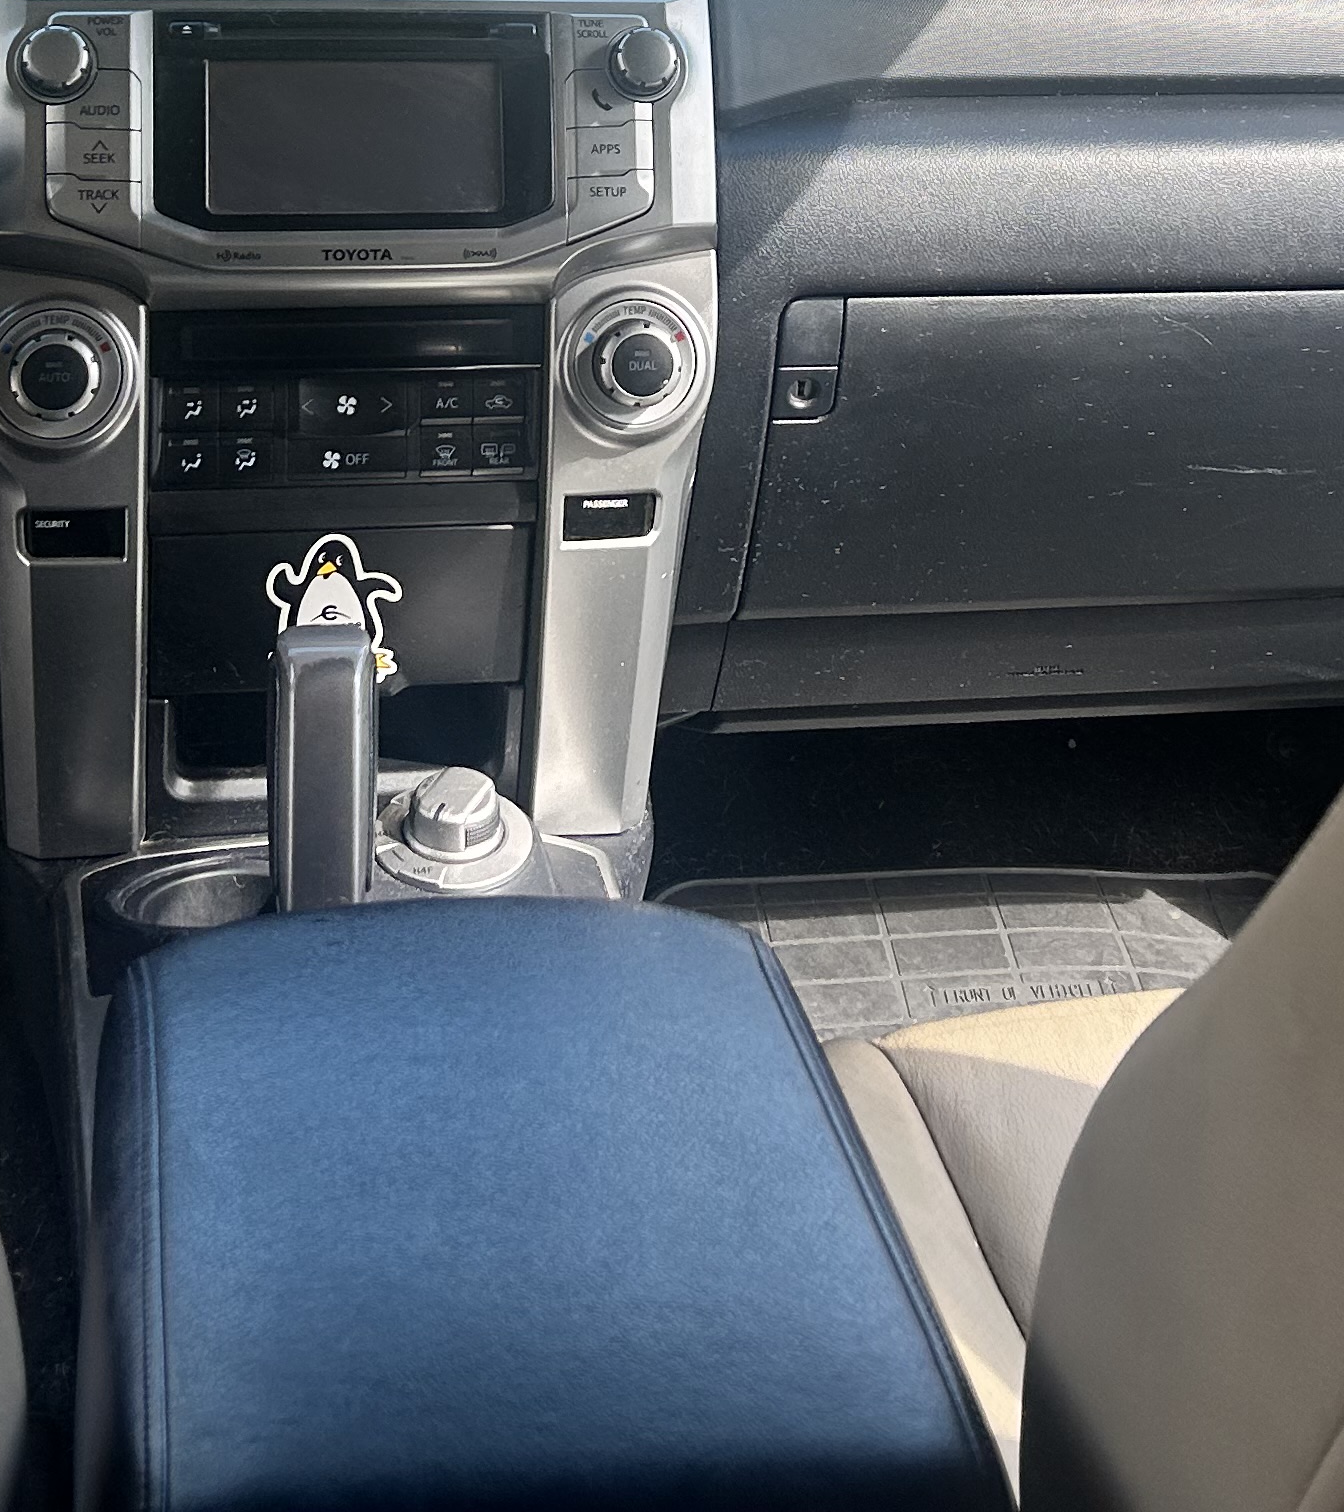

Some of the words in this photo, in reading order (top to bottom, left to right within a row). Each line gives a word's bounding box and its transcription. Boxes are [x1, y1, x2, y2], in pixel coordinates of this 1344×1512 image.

[578, 19, 605, 28] TUNE
[96, 27, 117, 37] VOL
[577, 29, 608, 38] SCROLL
[79, 104, 121, 116] AUDIO
[590, 143, 621, 155] APPS
[82, 152, 116, 164] SEEK
[77, 189, 120, 201] TRACK
[589, 186, 627, 198] SETUP
[321, 248, 393, 261] TOYOTA
[623, 305, 647, 316] TEMP
[44, 314, 71, 325] TEMP
[628, 360, 657, 371] DUAL
[38, 371, 71, 383] AUTO
[435, 396, 460, 409] A/C
[345, 453, 370, 466] OFF
[432, 458, 459, 467] FRONT
[489, 456, 510, 465] REAR
[34, 519, 71, 529] SECURITY
